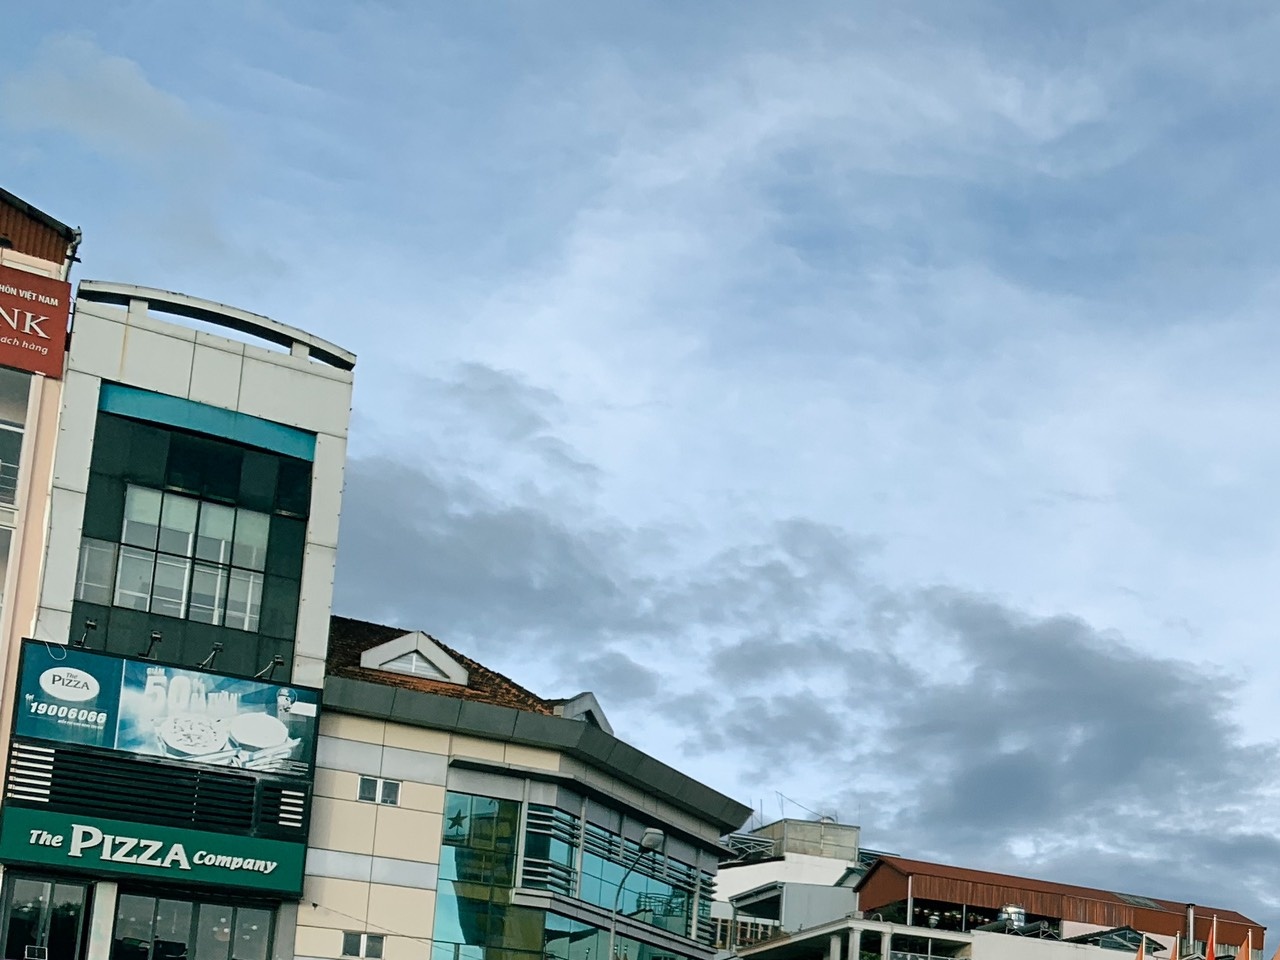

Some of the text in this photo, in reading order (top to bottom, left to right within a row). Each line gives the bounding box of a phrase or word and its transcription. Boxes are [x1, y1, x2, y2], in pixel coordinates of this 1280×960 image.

[19, 289, 36, 301] VIỆT
[38, 295, 59, 307] NAM
[21, 340, 48, 355] hàng
[51, 674, 90, 691] PIZZA
[30, 702, 108, 724] 19006066
[29, 823, 278, 875] The PIZZA Company
